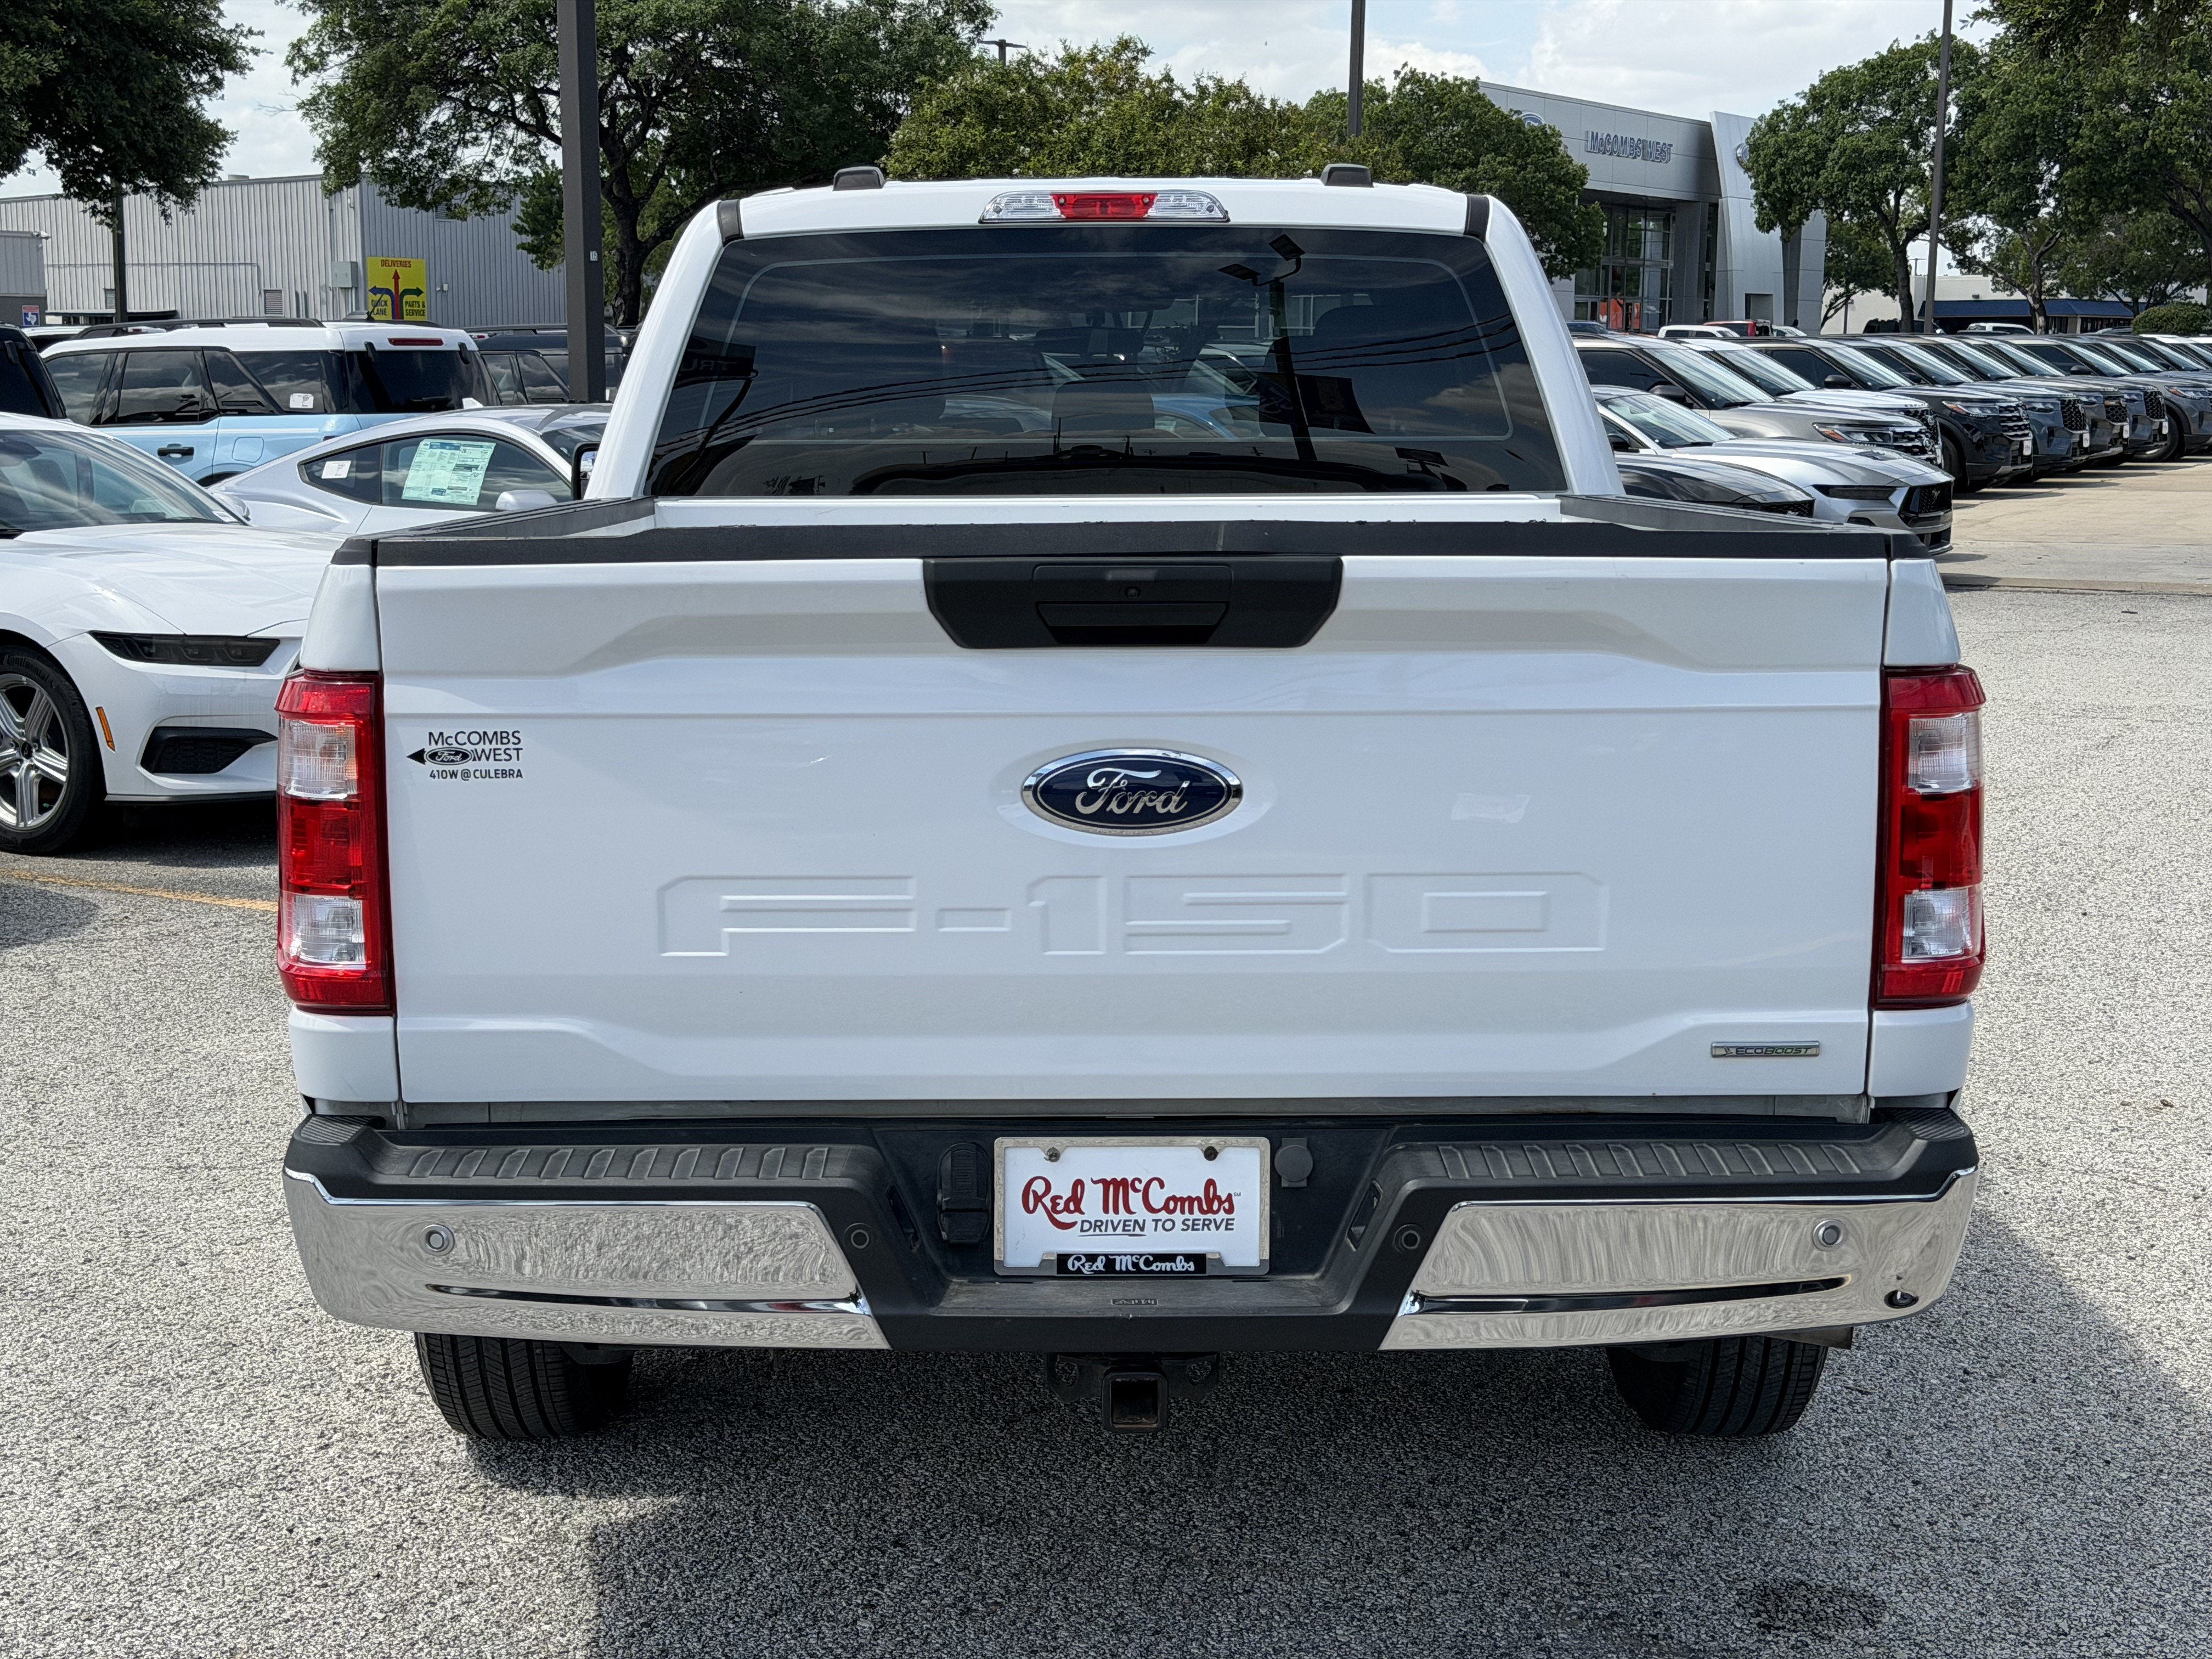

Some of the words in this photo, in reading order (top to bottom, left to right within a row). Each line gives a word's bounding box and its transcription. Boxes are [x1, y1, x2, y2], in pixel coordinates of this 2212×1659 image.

[1587, 131, 1642, 159] McCOMBS
[1645, 140, 1673, 163] WEST
[381, 259, 411, 268] DELIVERIES
[428, 730, 521, 746] McCOMBS
[435, 751, 462, 761] Ford
[474, 748, 523, 761] WEST
[1075, 768, 1190, 814] Ford
[657, 872, 1608, 957] F-150
[1735, 1047, 1813, 1055] ECOBOOST
[1022, 1176, 1086, 1230] Red
[1091, 1177, 1235, 1215] McCombs
[1080, 1219, 1146, 1233] DRIVEN
[1153, 1218, 1176, 1232] TO
[1181, 1217, 1235, 1232] SERVE
[1067, 1255, 1106, 1274] Red
[1108, 1254, 1195, 1272] McCombs
